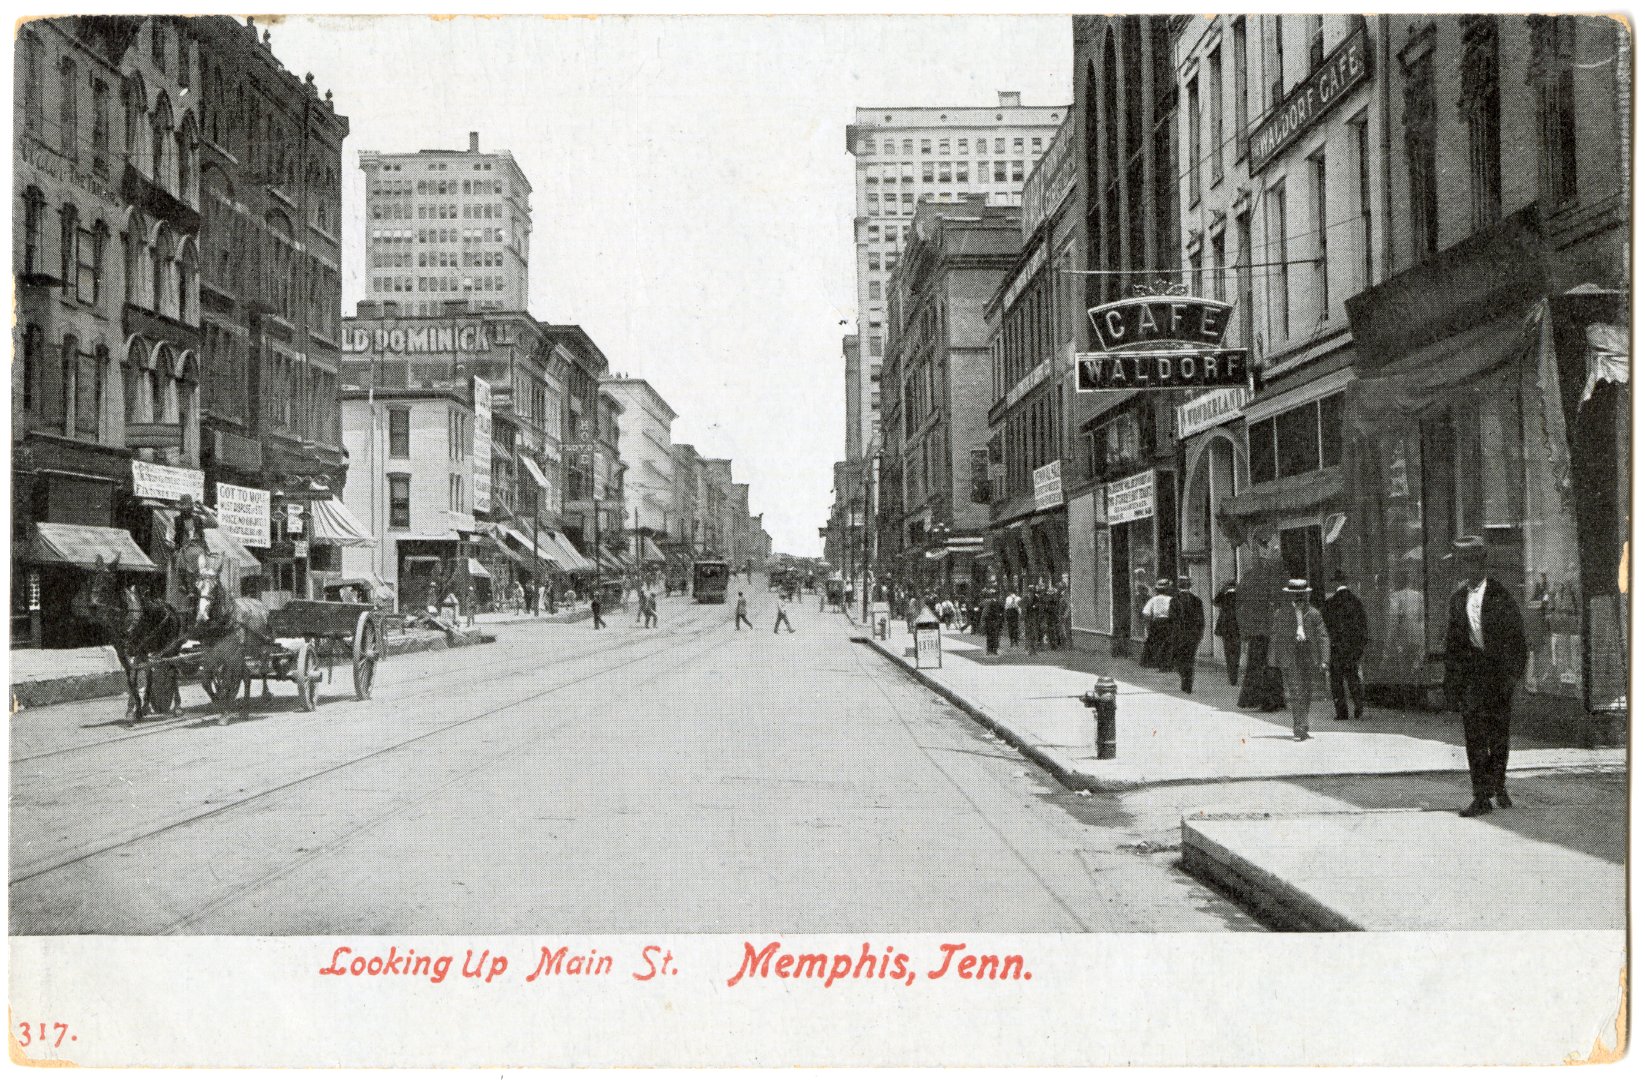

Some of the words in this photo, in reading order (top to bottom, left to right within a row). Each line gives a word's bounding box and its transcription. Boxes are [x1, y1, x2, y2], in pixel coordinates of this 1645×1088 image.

[1258, 88, 1314, 158] WALDORF
[1319, 46, 1359, 103] CAFE
[1105, 304, 1221, 339] CAFE
[373, 326, 490, 352] DOMINICK
[1084, 355, 1241, 383] WALDORF
[236, 489, 249, 503] TO
